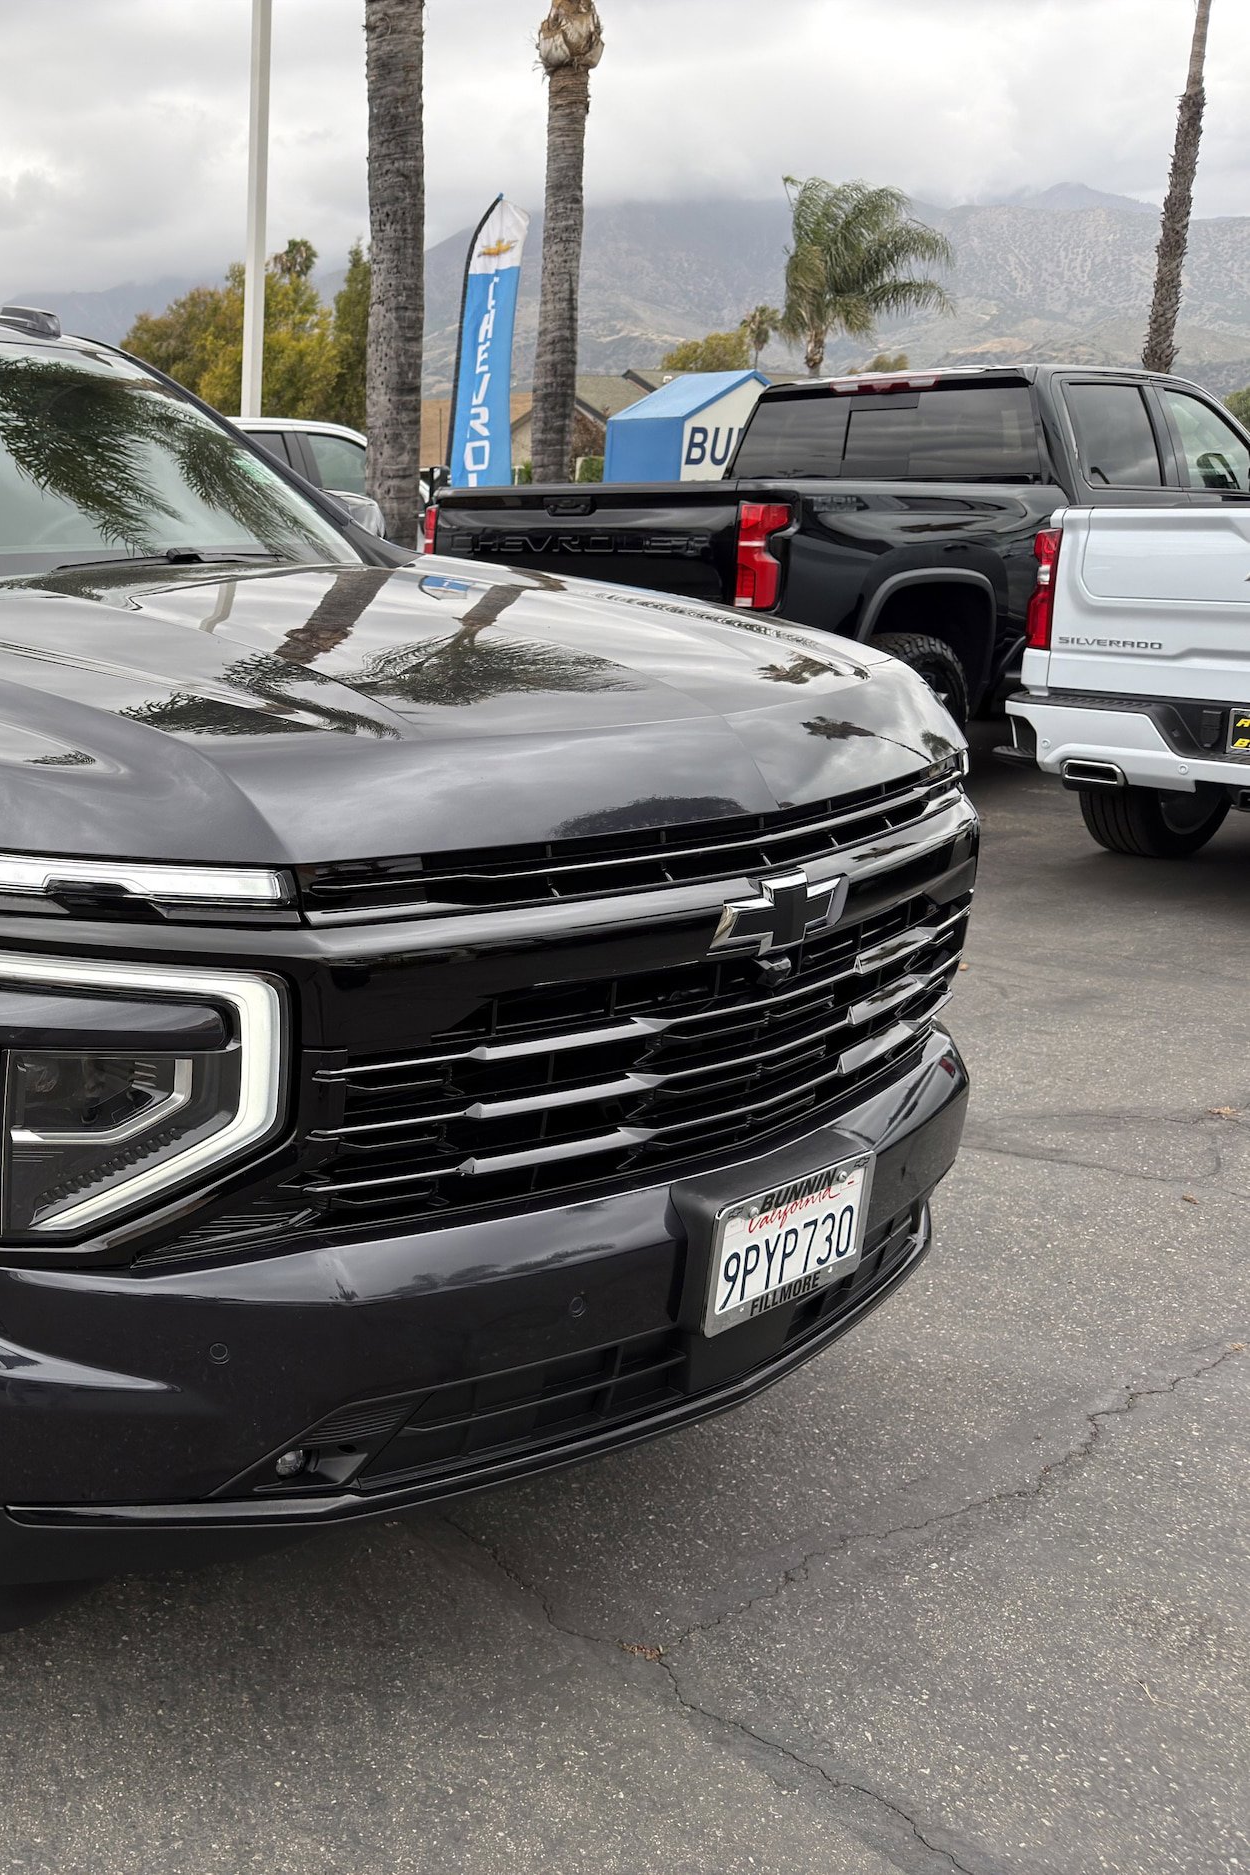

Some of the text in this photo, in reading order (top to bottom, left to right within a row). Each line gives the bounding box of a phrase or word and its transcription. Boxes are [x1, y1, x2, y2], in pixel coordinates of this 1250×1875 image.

[684, 426, 745, 466] BU
[450, 536, 710, 553] CHEVROLET
[1059, 636, 1163, 650] SILVERADO
[749, 1187, 841, 1234] California
[760, 1168, 837, 1213] BUNNIN
[718, 1204, 854, 1312] 9PYP730
[750, 1271, 821, 1317] FILLMORE
